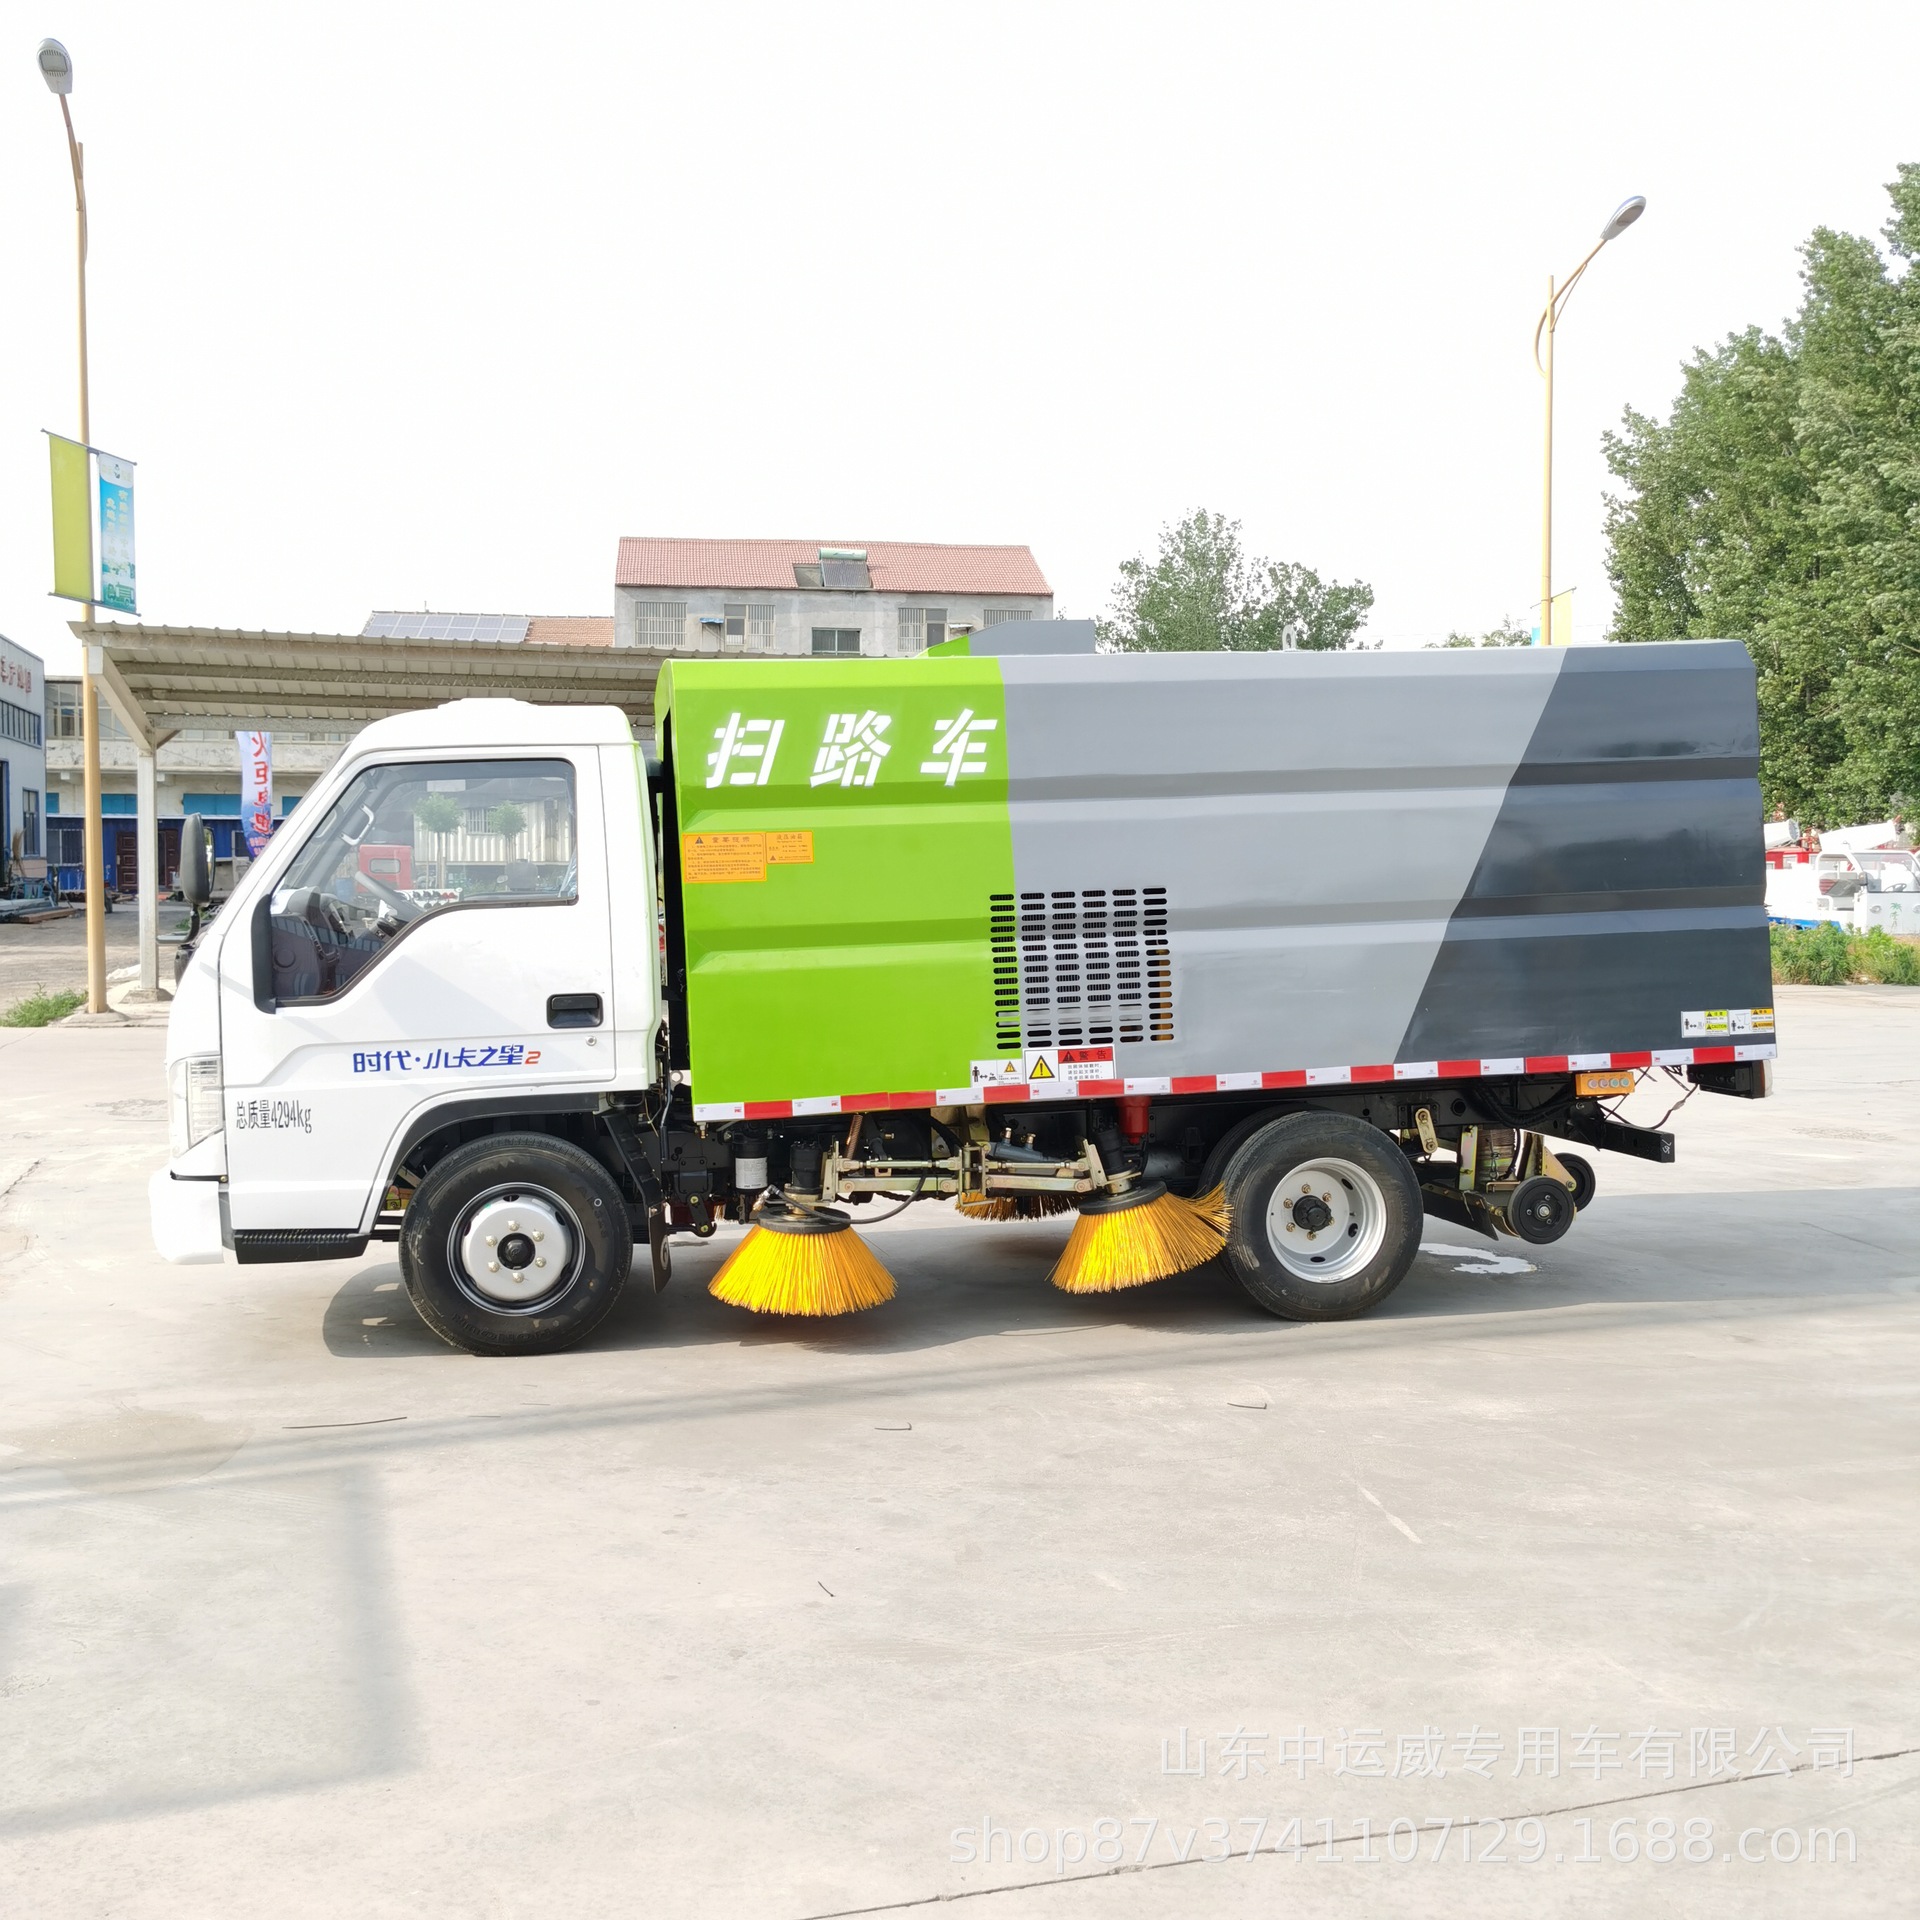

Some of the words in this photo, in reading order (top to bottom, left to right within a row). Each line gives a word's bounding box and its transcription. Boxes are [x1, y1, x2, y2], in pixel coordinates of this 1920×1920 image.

[706, 708, 998, 788] 扫路车
[1079, 1050, 1106, 1060] 警告
[236, 1099, 312, 1134] 总质量4294kg
